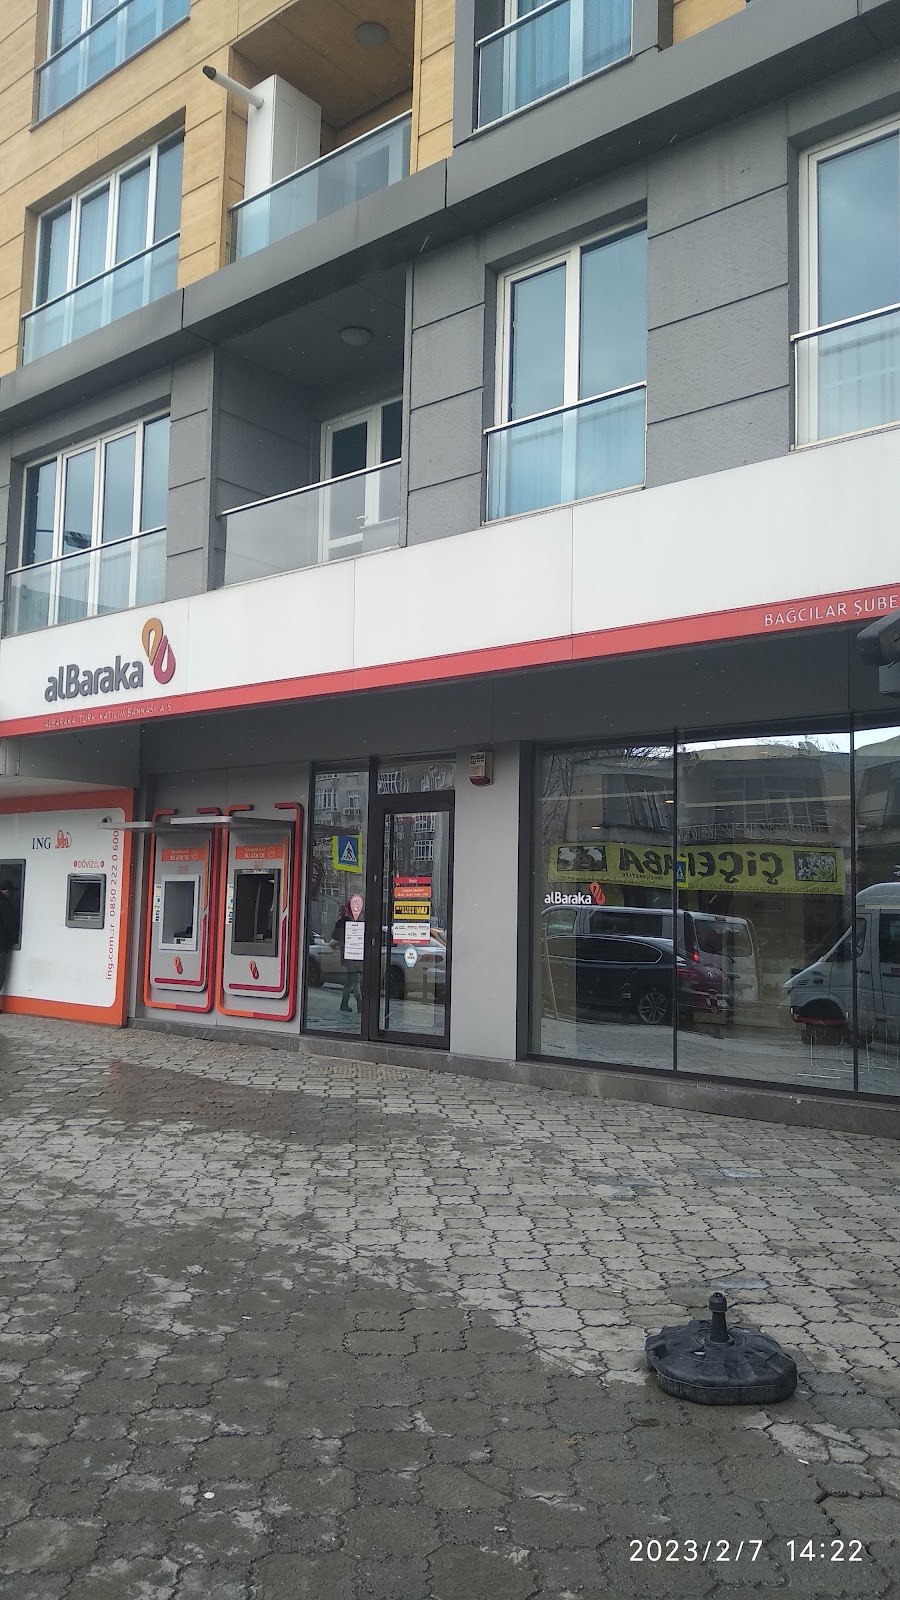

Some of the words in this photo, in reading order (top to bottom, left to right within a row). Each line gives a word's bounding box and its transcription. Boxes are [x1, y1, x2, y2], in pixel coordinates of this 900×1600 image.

[764, 602, 847, 627] BAĞCILAR
[854, 595, 899, 616] ŞUBE
[44, 655, 144, 702] alBaraka
[44, 716, 76, 728] ALBARAKA
[99, 710, 126, 721] KATILIM
[127, 704, 156, 717] BANKASI
[32, 837, 51, 850] ING
[109, 888, 117, 917] 0850
[544, 891, 592, 905] alBaraka
